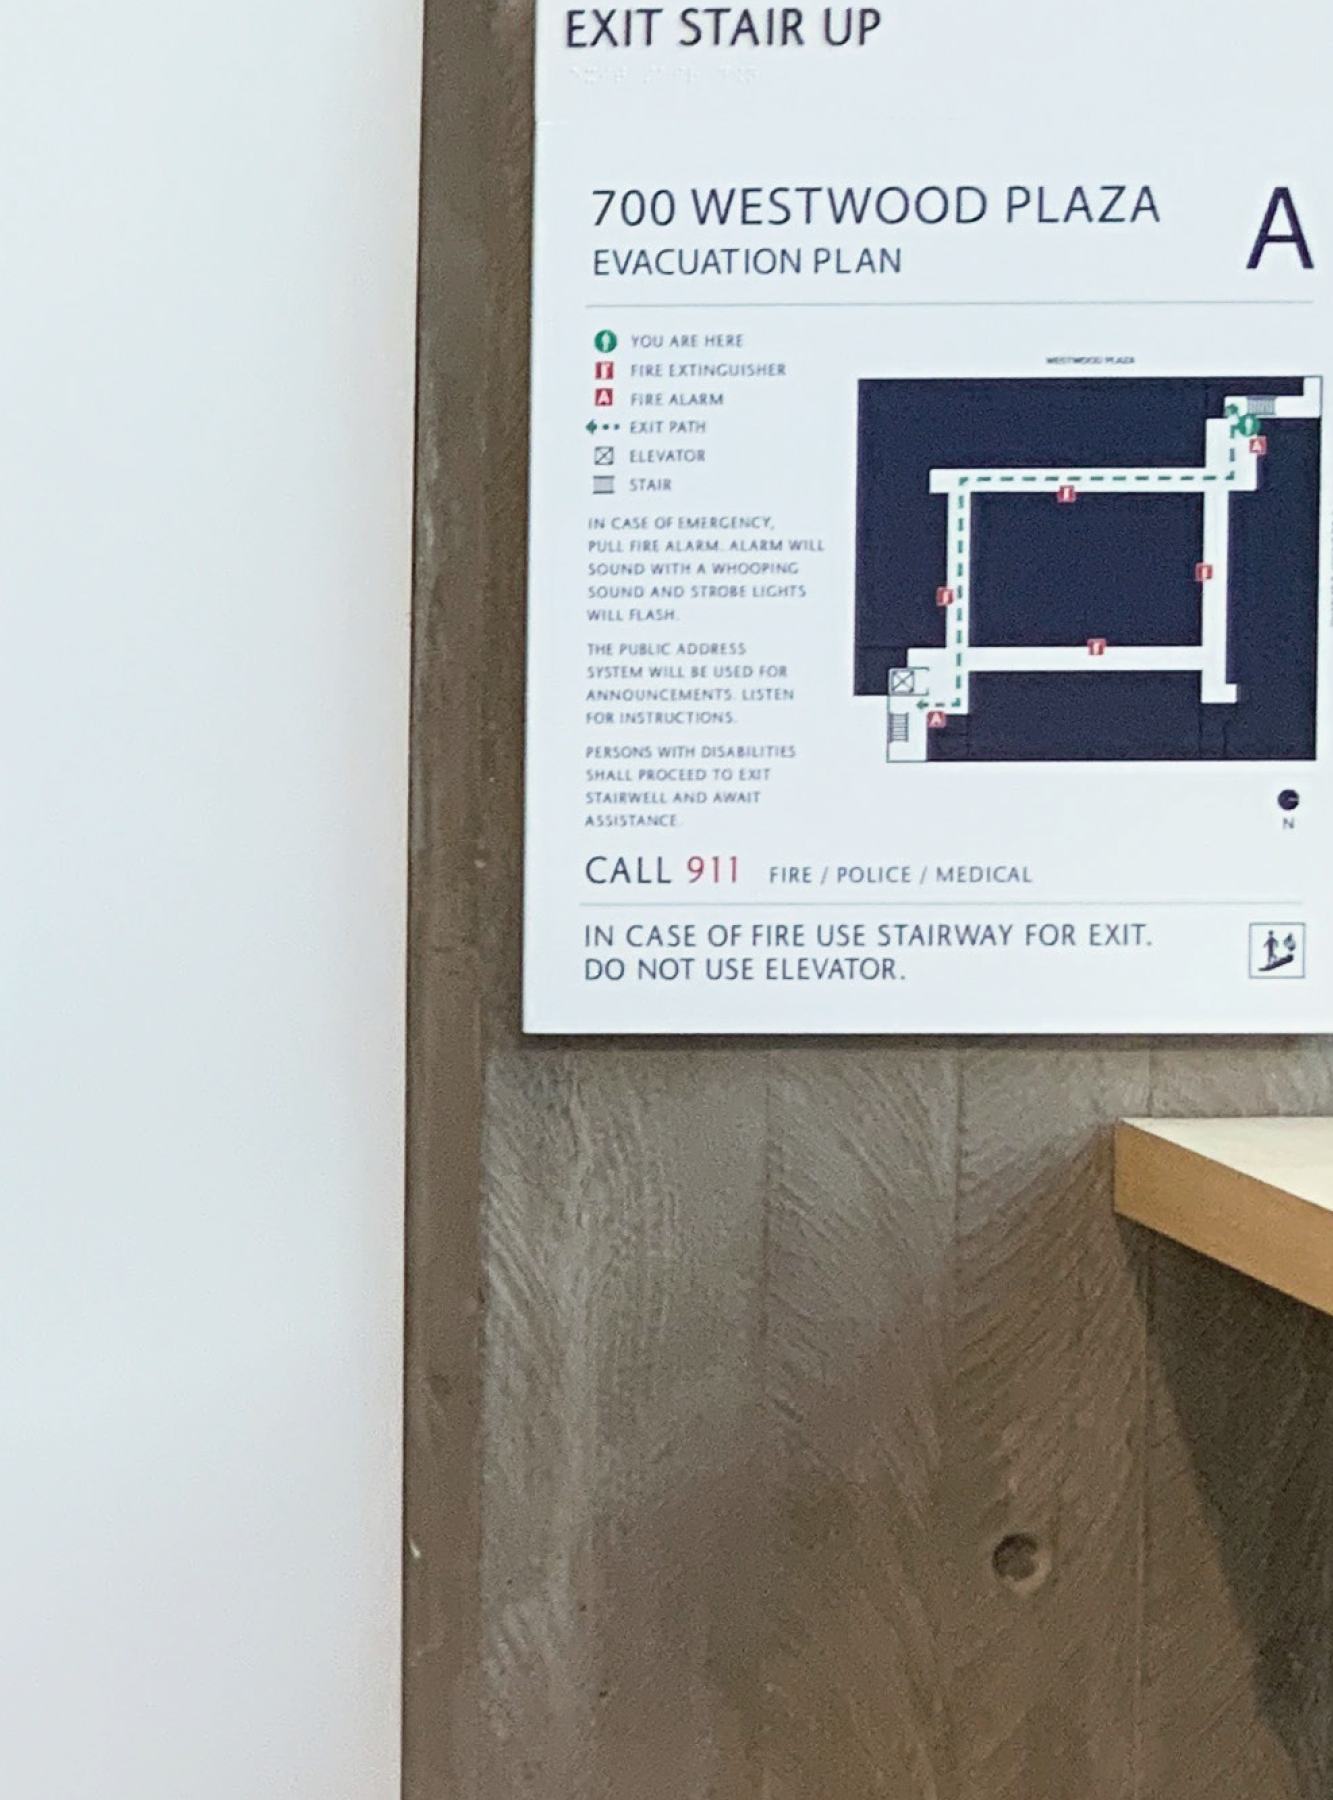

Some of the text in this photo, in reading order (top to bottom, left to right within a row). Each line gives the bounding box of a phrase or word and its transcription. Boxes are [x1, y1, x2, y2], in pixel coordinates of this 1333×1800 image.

[566, 7, 882, 49] EXIT STAIR UP
[592, 184, 1161, 227] 700 WESTWOOD PLAZA
[1245, 186, 1315, 270] A
[593, 247, 902, 276] EVACUATION PLAN
[630, 333, 743, 349] YOU ARE HERE
[630, 362, 787, 378] FIRE EXTINGUISHER
[630, 392, 724, 407] FIRE ALARM
[629, 419, 706, 435] EXIT PATH
[629, 448, 706, 464] ELEVATOR
[629, 477, 672, 492] STAIR
[588, 515, 775, 531] IN CASE OF EMERGENCY,
[588, 539, 624, 554] PULL
[629, 539, 660, 553] FIRE
[728, 538, 783, 552] ALARM
[788, 539, 825, 552] WILL
[588, 561, 799, 576] SOUND WITH A WHOOPING
[588, 584, 807, 600] SOUND AND STROBE LIGHTS
[586, 609, 624, 622] WILL
[587, 642, 747, 657] THE PUBLIC ADDRESS
[587, 664, 788, 679] SYSTEM WILL BE USED FOR
[741, 687, 795, 702] LISTEN
[585, 711, 615, 725] FOR
[585, 744, 797, 760] PERSONS WITH DISABILITIES
[585, 767, 771, 783] SHALL PROCEED TO EXIT
[585, 790, 761, 805] STAIRWELL AND AWAIT
[1282, 817, 1296, 830] N
[585, 855, 1033, 886] CALL 911 FIRE / POLICE / MEDICAL
[584, 922, 1152, 948] IN CASE OF FIRE USE STAIRWAY FOR EXIT.
[584, 956, 906, 982] DO NOT USE ELEVATOR.
